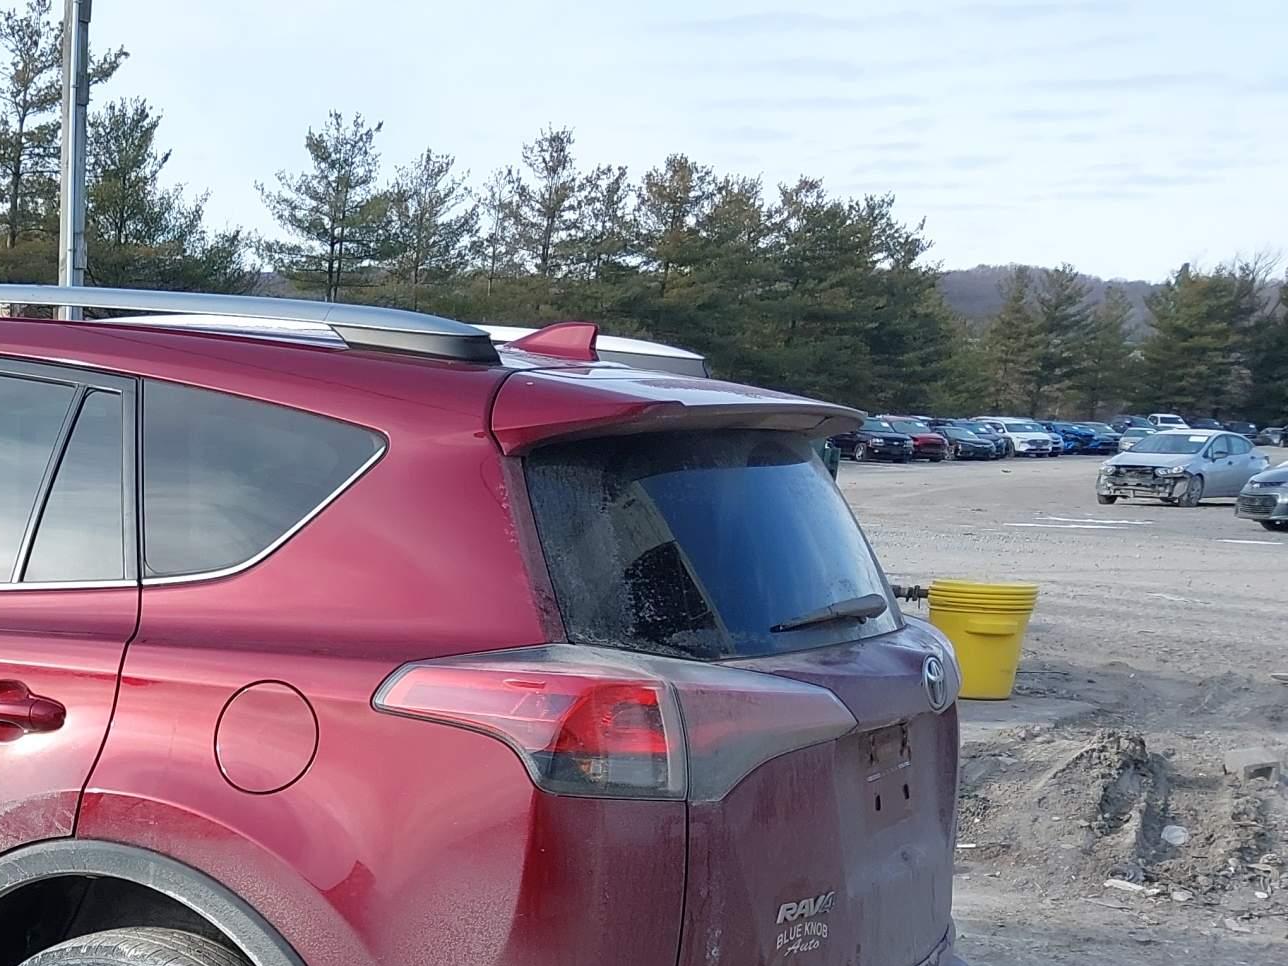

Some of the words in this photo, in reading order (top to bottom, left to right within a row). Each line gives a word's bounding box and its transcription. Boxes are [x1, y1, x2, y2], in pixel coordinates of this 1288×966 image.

[776, 891, 835, 923] RAV4
[777, 924, 802, 949] BLUE
[804, 921, 828, 938] KNOB
[784, 938, 820, 956] Auto
